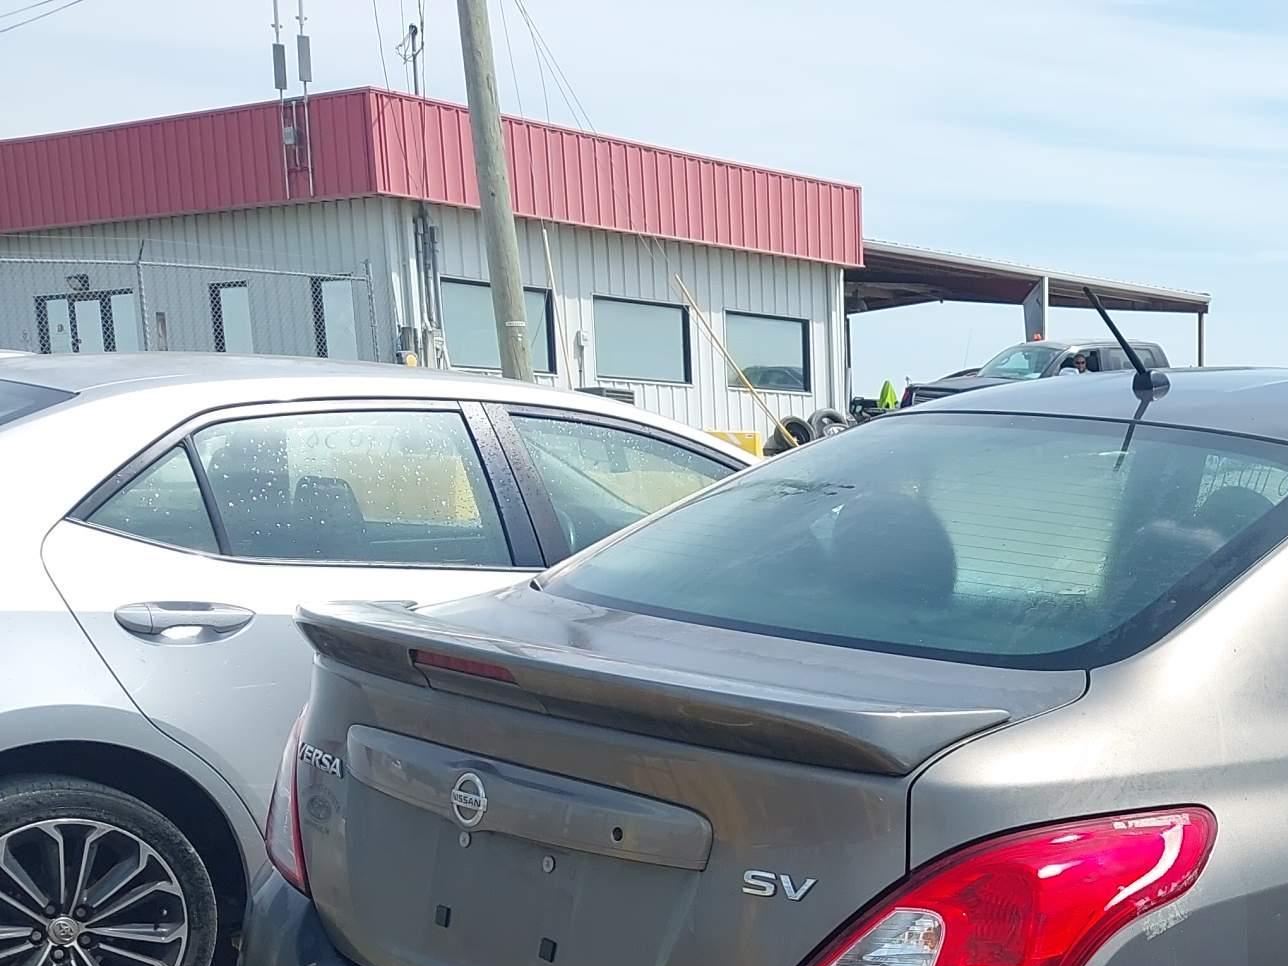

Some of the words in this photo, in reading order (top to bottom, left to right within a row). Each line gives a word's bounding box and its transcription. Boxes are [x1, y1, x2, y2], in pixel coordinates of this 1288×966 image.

[298, 742, 344, 779] VERSA
[453, 791, 481, 807] NISSAN
[742, 870, 818, 902] SV
